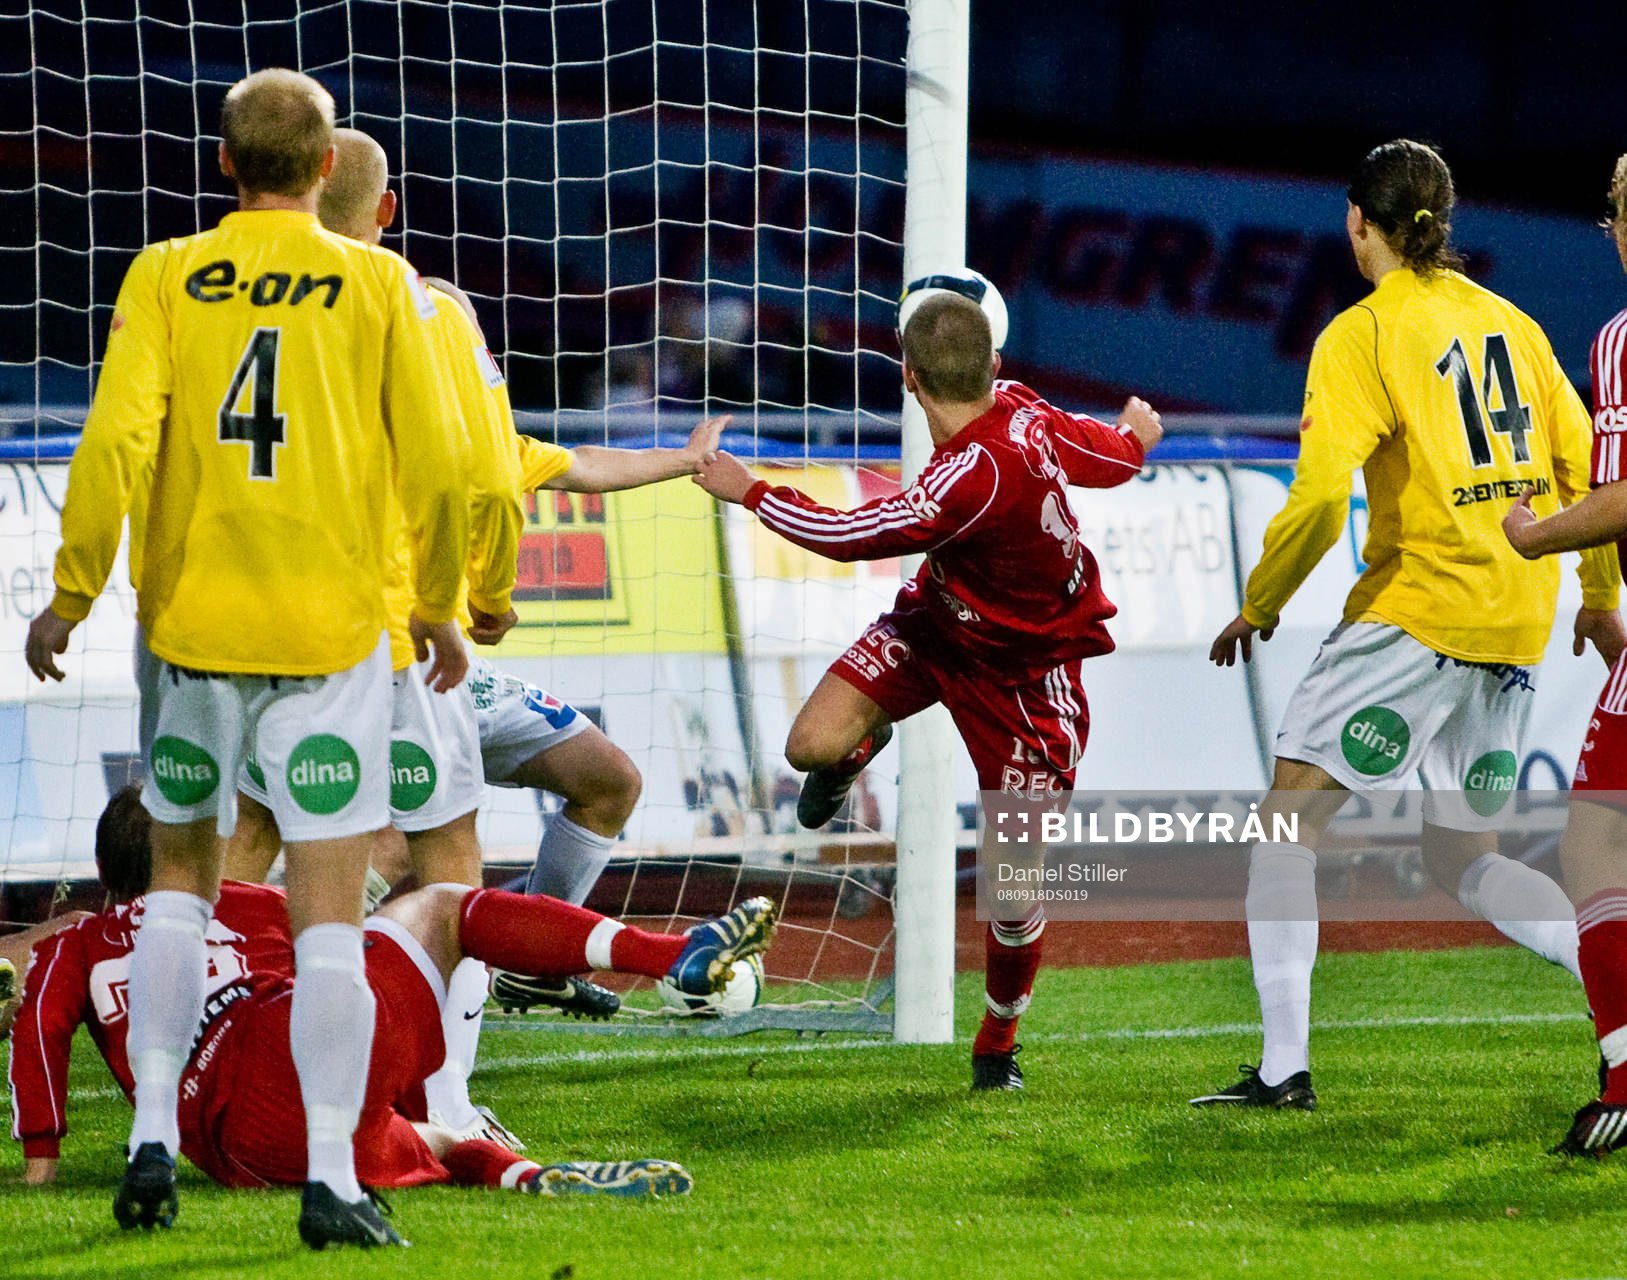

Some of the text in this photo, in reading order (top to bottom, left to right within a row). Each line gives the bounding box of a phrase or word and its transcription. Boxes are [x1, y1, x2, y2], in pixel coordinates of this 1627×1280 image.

[217, 327, 288, 482] 4
[1434, 331, 1533, 470] 14
[1349, 719, 1401, 760] dina
[154, 755, 213, 783] dina
[291, 759, 354, 787] dina
[390, 763, 430, 786] ina
[1469, 767, 1514, 792] dina
